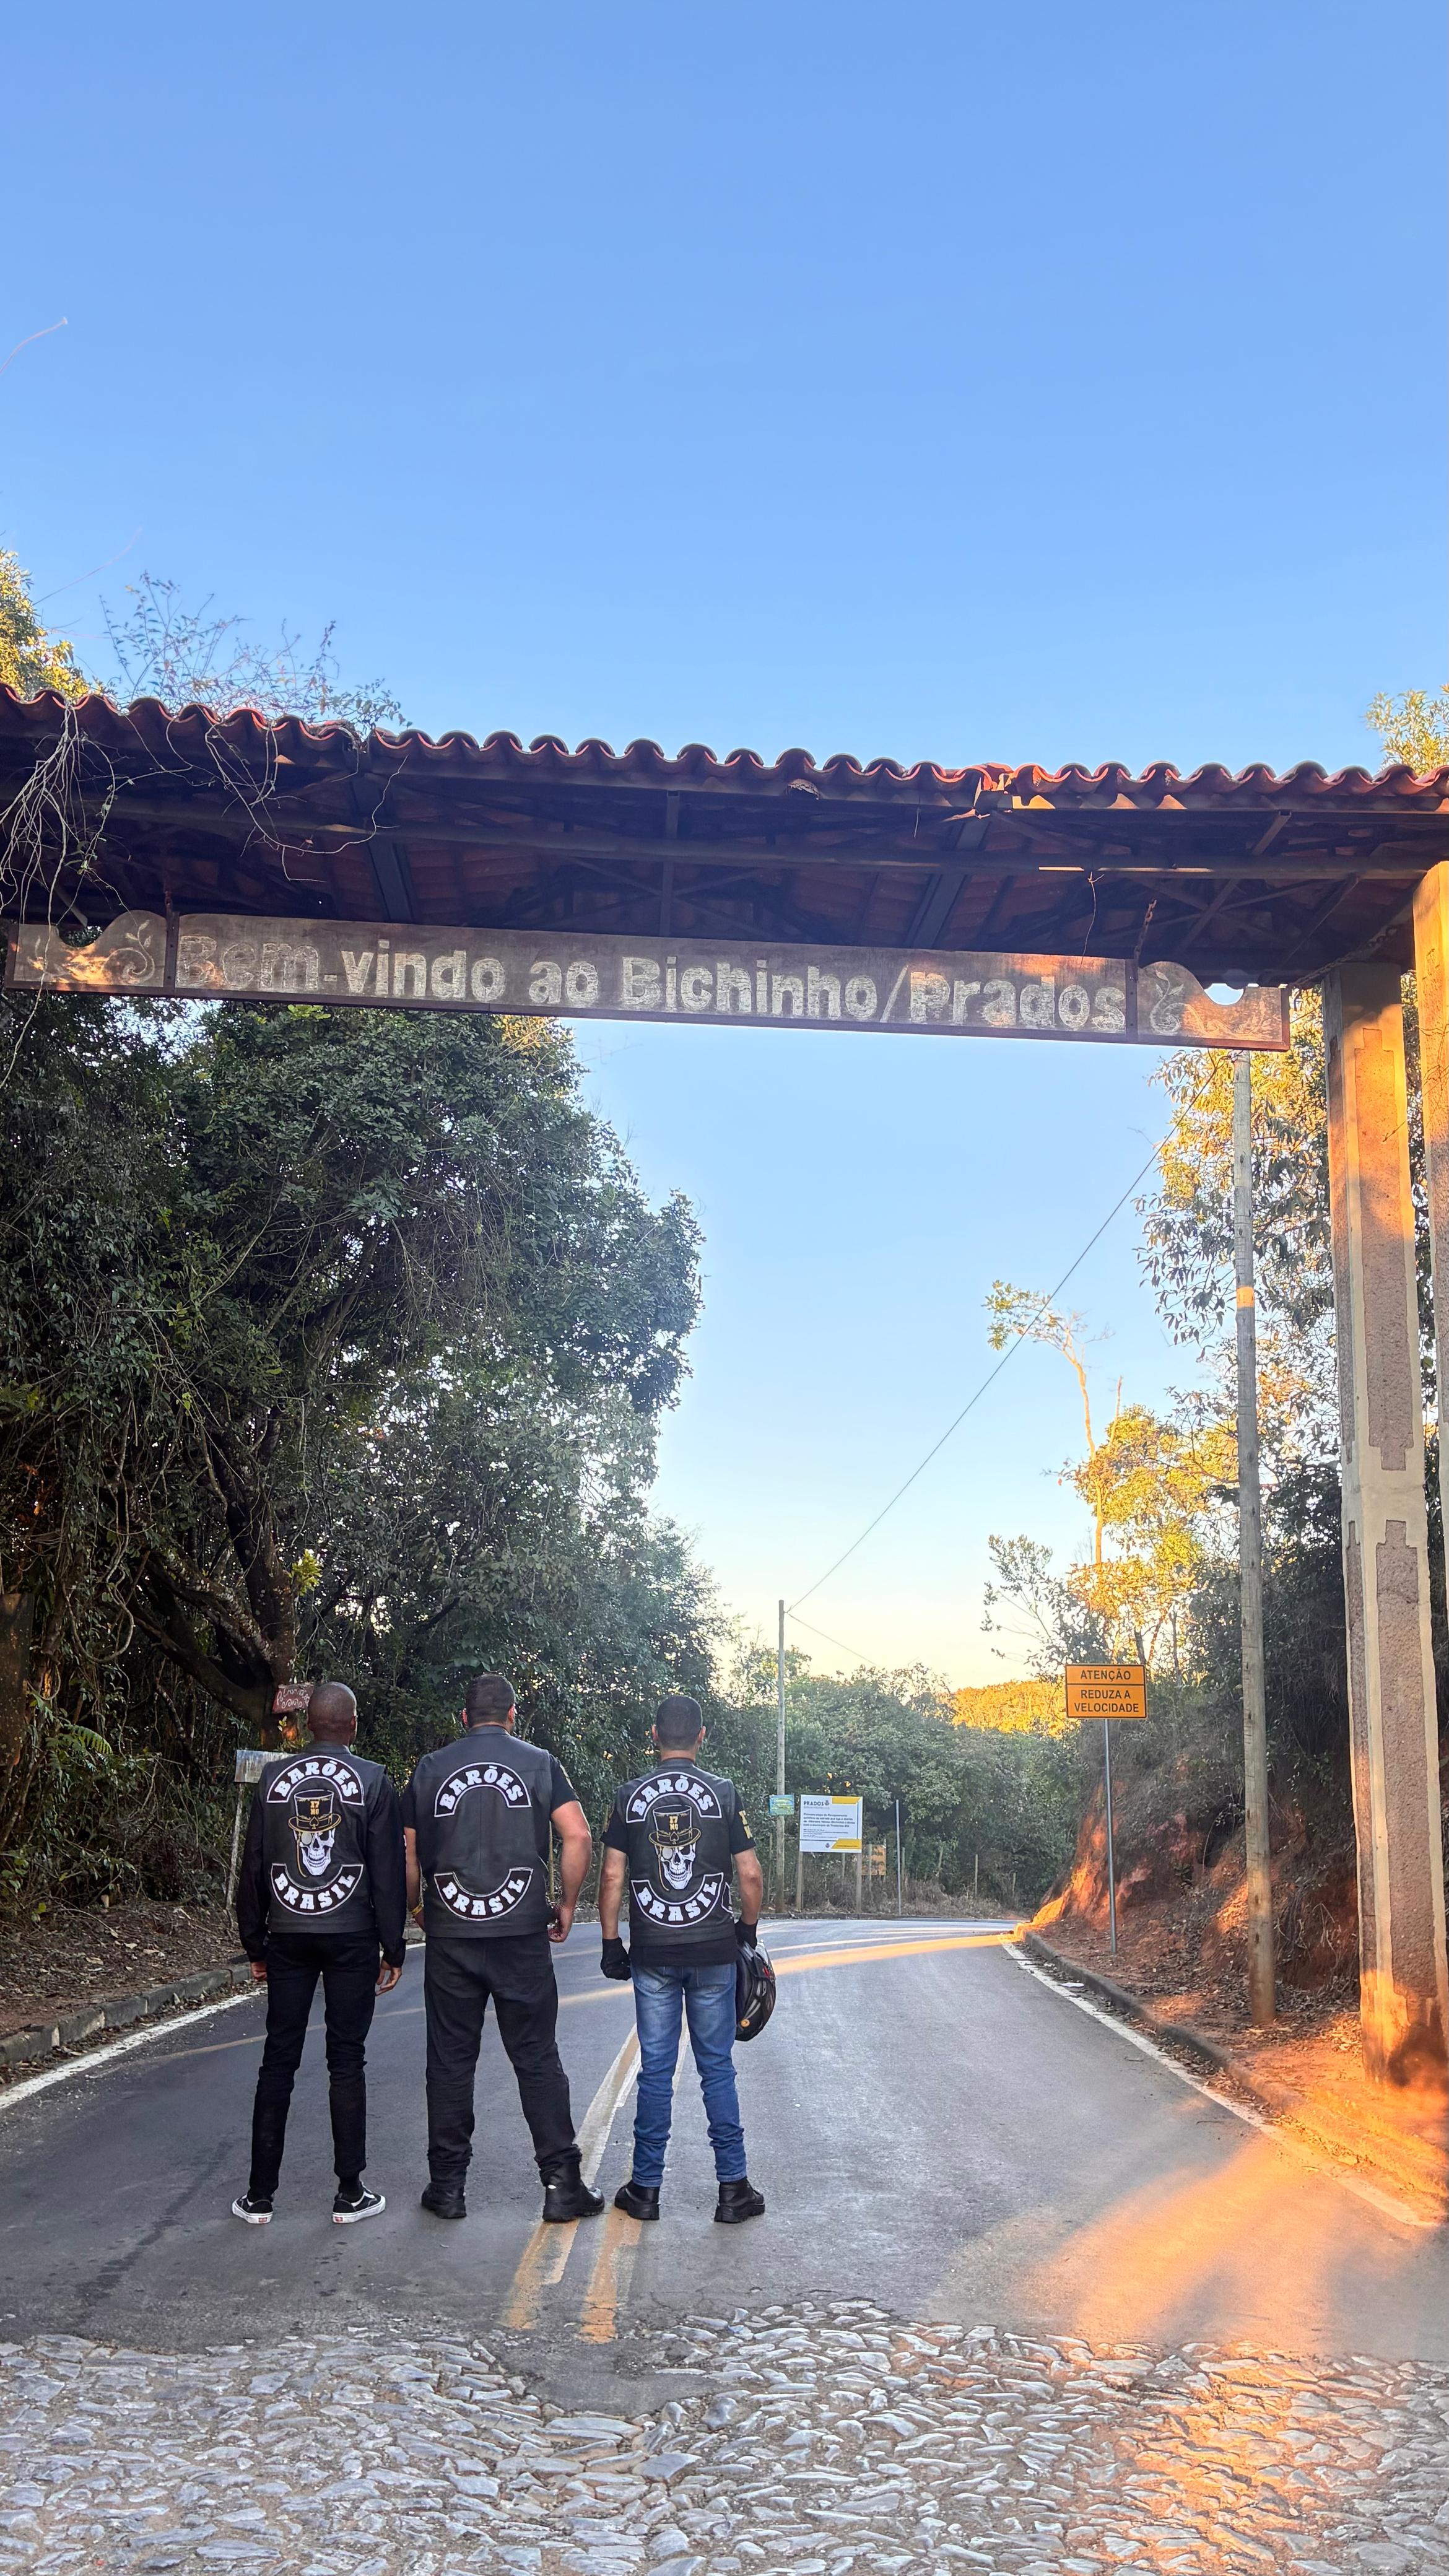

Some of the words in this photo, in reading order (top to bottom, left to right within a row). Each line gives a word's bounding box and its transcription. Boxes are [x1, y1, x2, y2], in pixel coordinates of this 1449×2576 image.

[176, 934, 507, 1003] Bem-vindo
[529, 960, 599, 1004] ao
[1081, 1668, 1131, 1682] ATENÇÃO
[1081, 1689, 1121, 1699] REDUZA
[1124, 1690, 1131, 1699] A
[1074, 1702, 1139, 1712] VELOCIDADE
[274, 1760, 359, 1798] BARÕES
[440, 1765, 524, 1809] BARÕES
[632, 1775, 715, 1817] BARÕES
[274, 1873, 355, 1910] BRASIL
[442, 1877, 524, 1916] BRASIL
[637, 1881, 719, 1921] BRASIL
